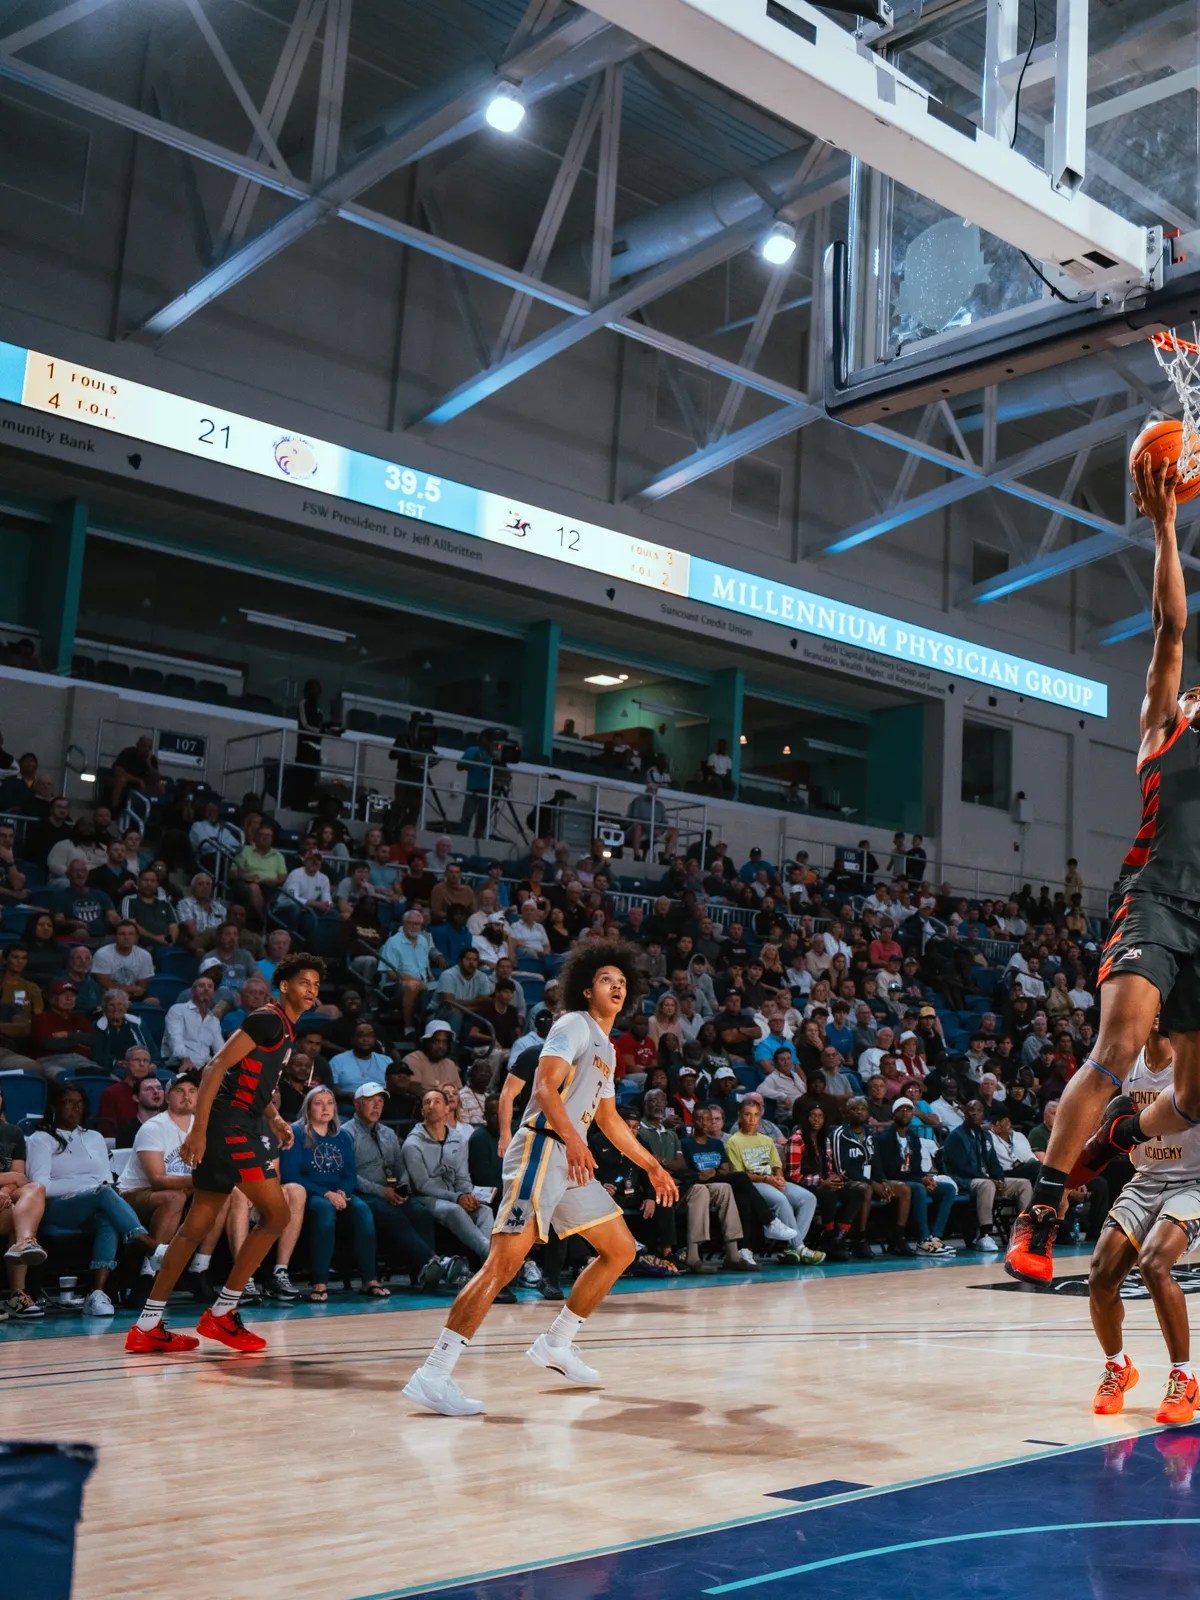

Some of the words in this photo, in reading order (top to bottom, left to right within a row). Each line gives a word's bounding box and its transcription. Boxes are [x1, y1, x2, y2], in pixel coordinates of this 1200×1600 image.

[47, 362, 55, 379] 1
[71, 373, 118, 395] FOULS
[48, 392, 61, 409] 4
[0, 419, 55, 444] munity
[60, 432, 95, 452] Bank
[198, 418, 231, 449] 21
[384, 465, 441, 502] 39.5
[302, 501, 330, 518] FSW
[397, 499, 426, 519] 1ST
[556, 526, 580, 552] 12
[660, 603, 699, 621] Suncoast
[701, 615, 727, 629] Credit
[728, 623, 753, 637] Union
[711, 573, 887, 647] MILLENNIUM
[895, 628, 1019, 687] PHYSICIAN
[1025, 669, 1093, 707] GROUP
[176, 738, 197, 752] 107
[1129, 1090, 1161, 1105] MONTV
[1144, 1145, 1183, 1160] ACADEMY
